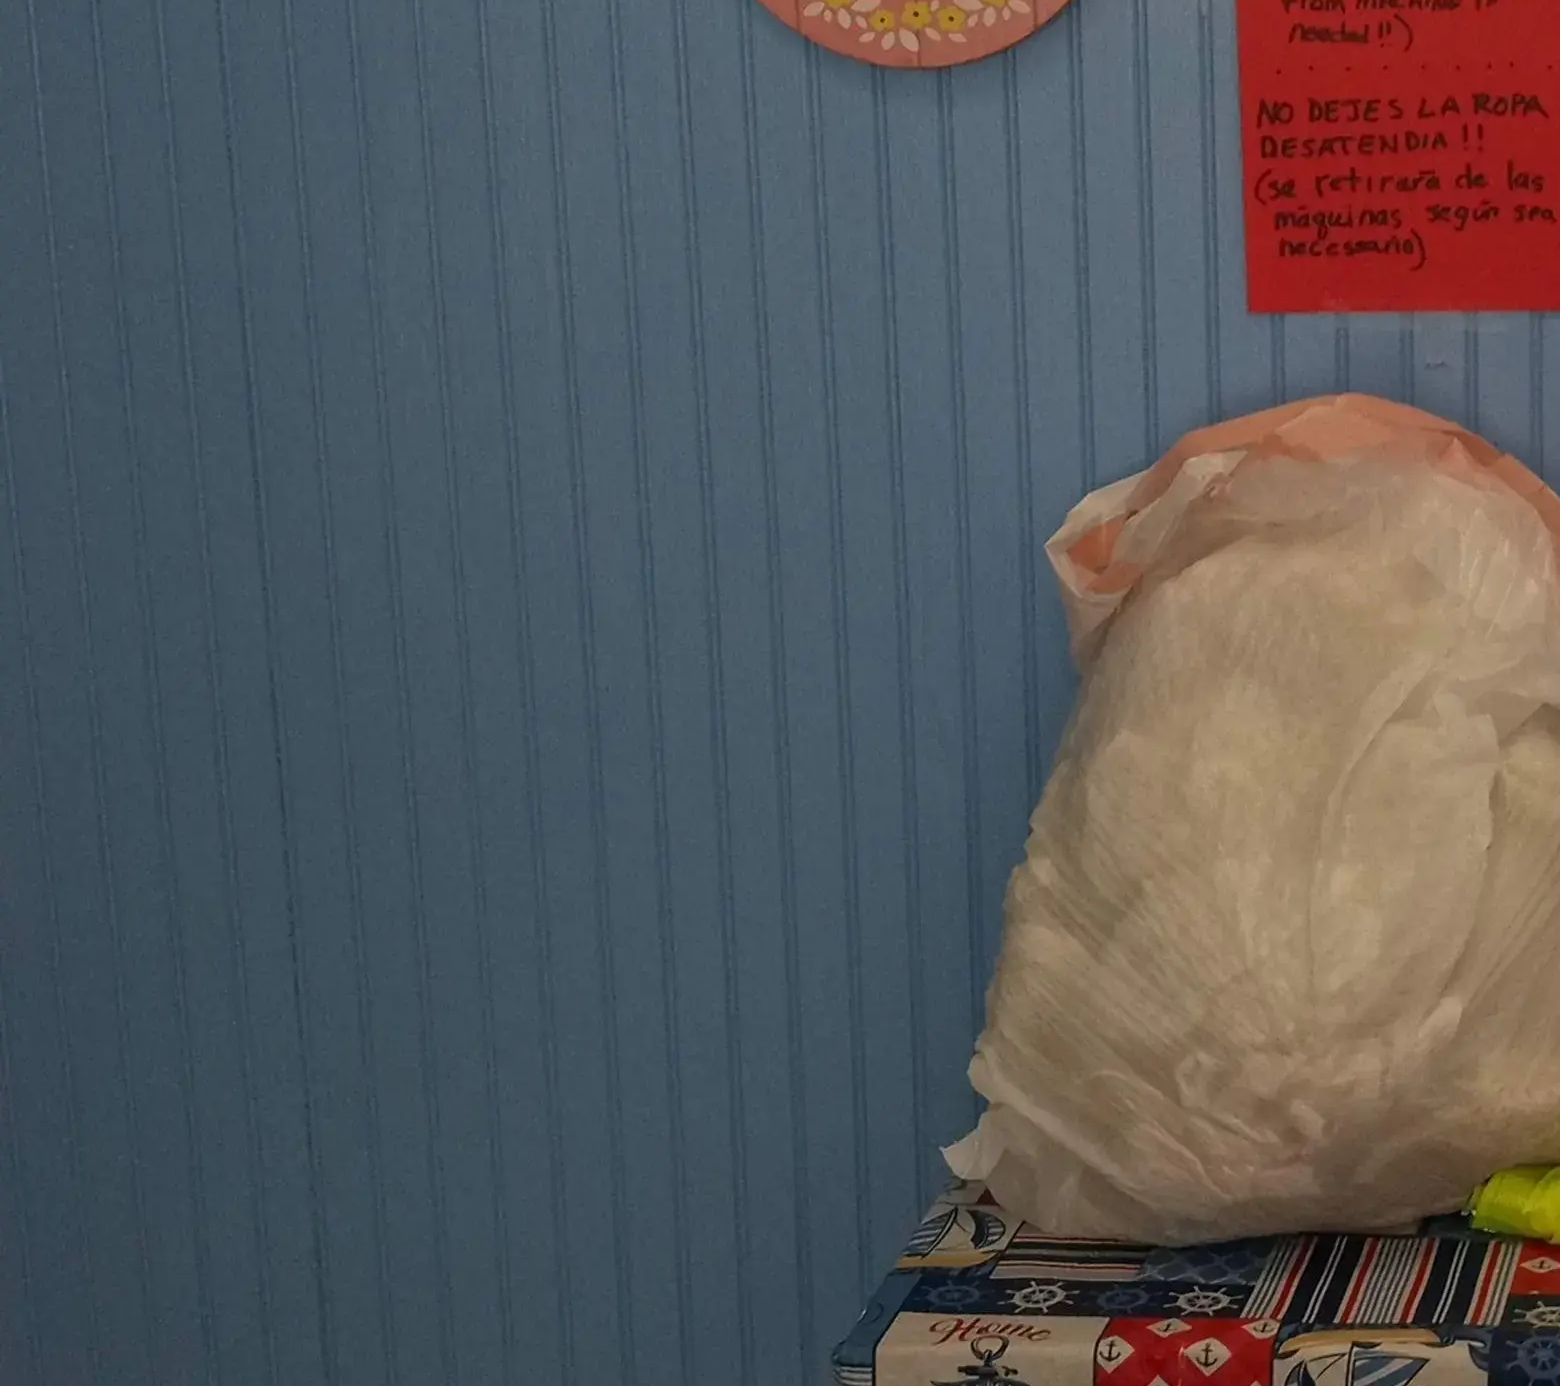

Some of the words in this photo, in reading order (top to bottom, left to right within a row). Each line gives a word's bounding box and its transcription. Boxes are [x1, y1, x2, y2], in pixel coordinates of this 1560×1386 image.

[1257, 99, 1295, 129] NO
[1308, 97, 1404, 123] DEJES
[1418, 95, 1461, 120] LA
[1472, 93, 1549, 119] ROPA
[1260, 130, 1449, 159] DESATENDIA
[1454, 164, 1488, 191] de
[1507, 160, 1545, 193] las
[929, 1317, 1051, 1345] Home
